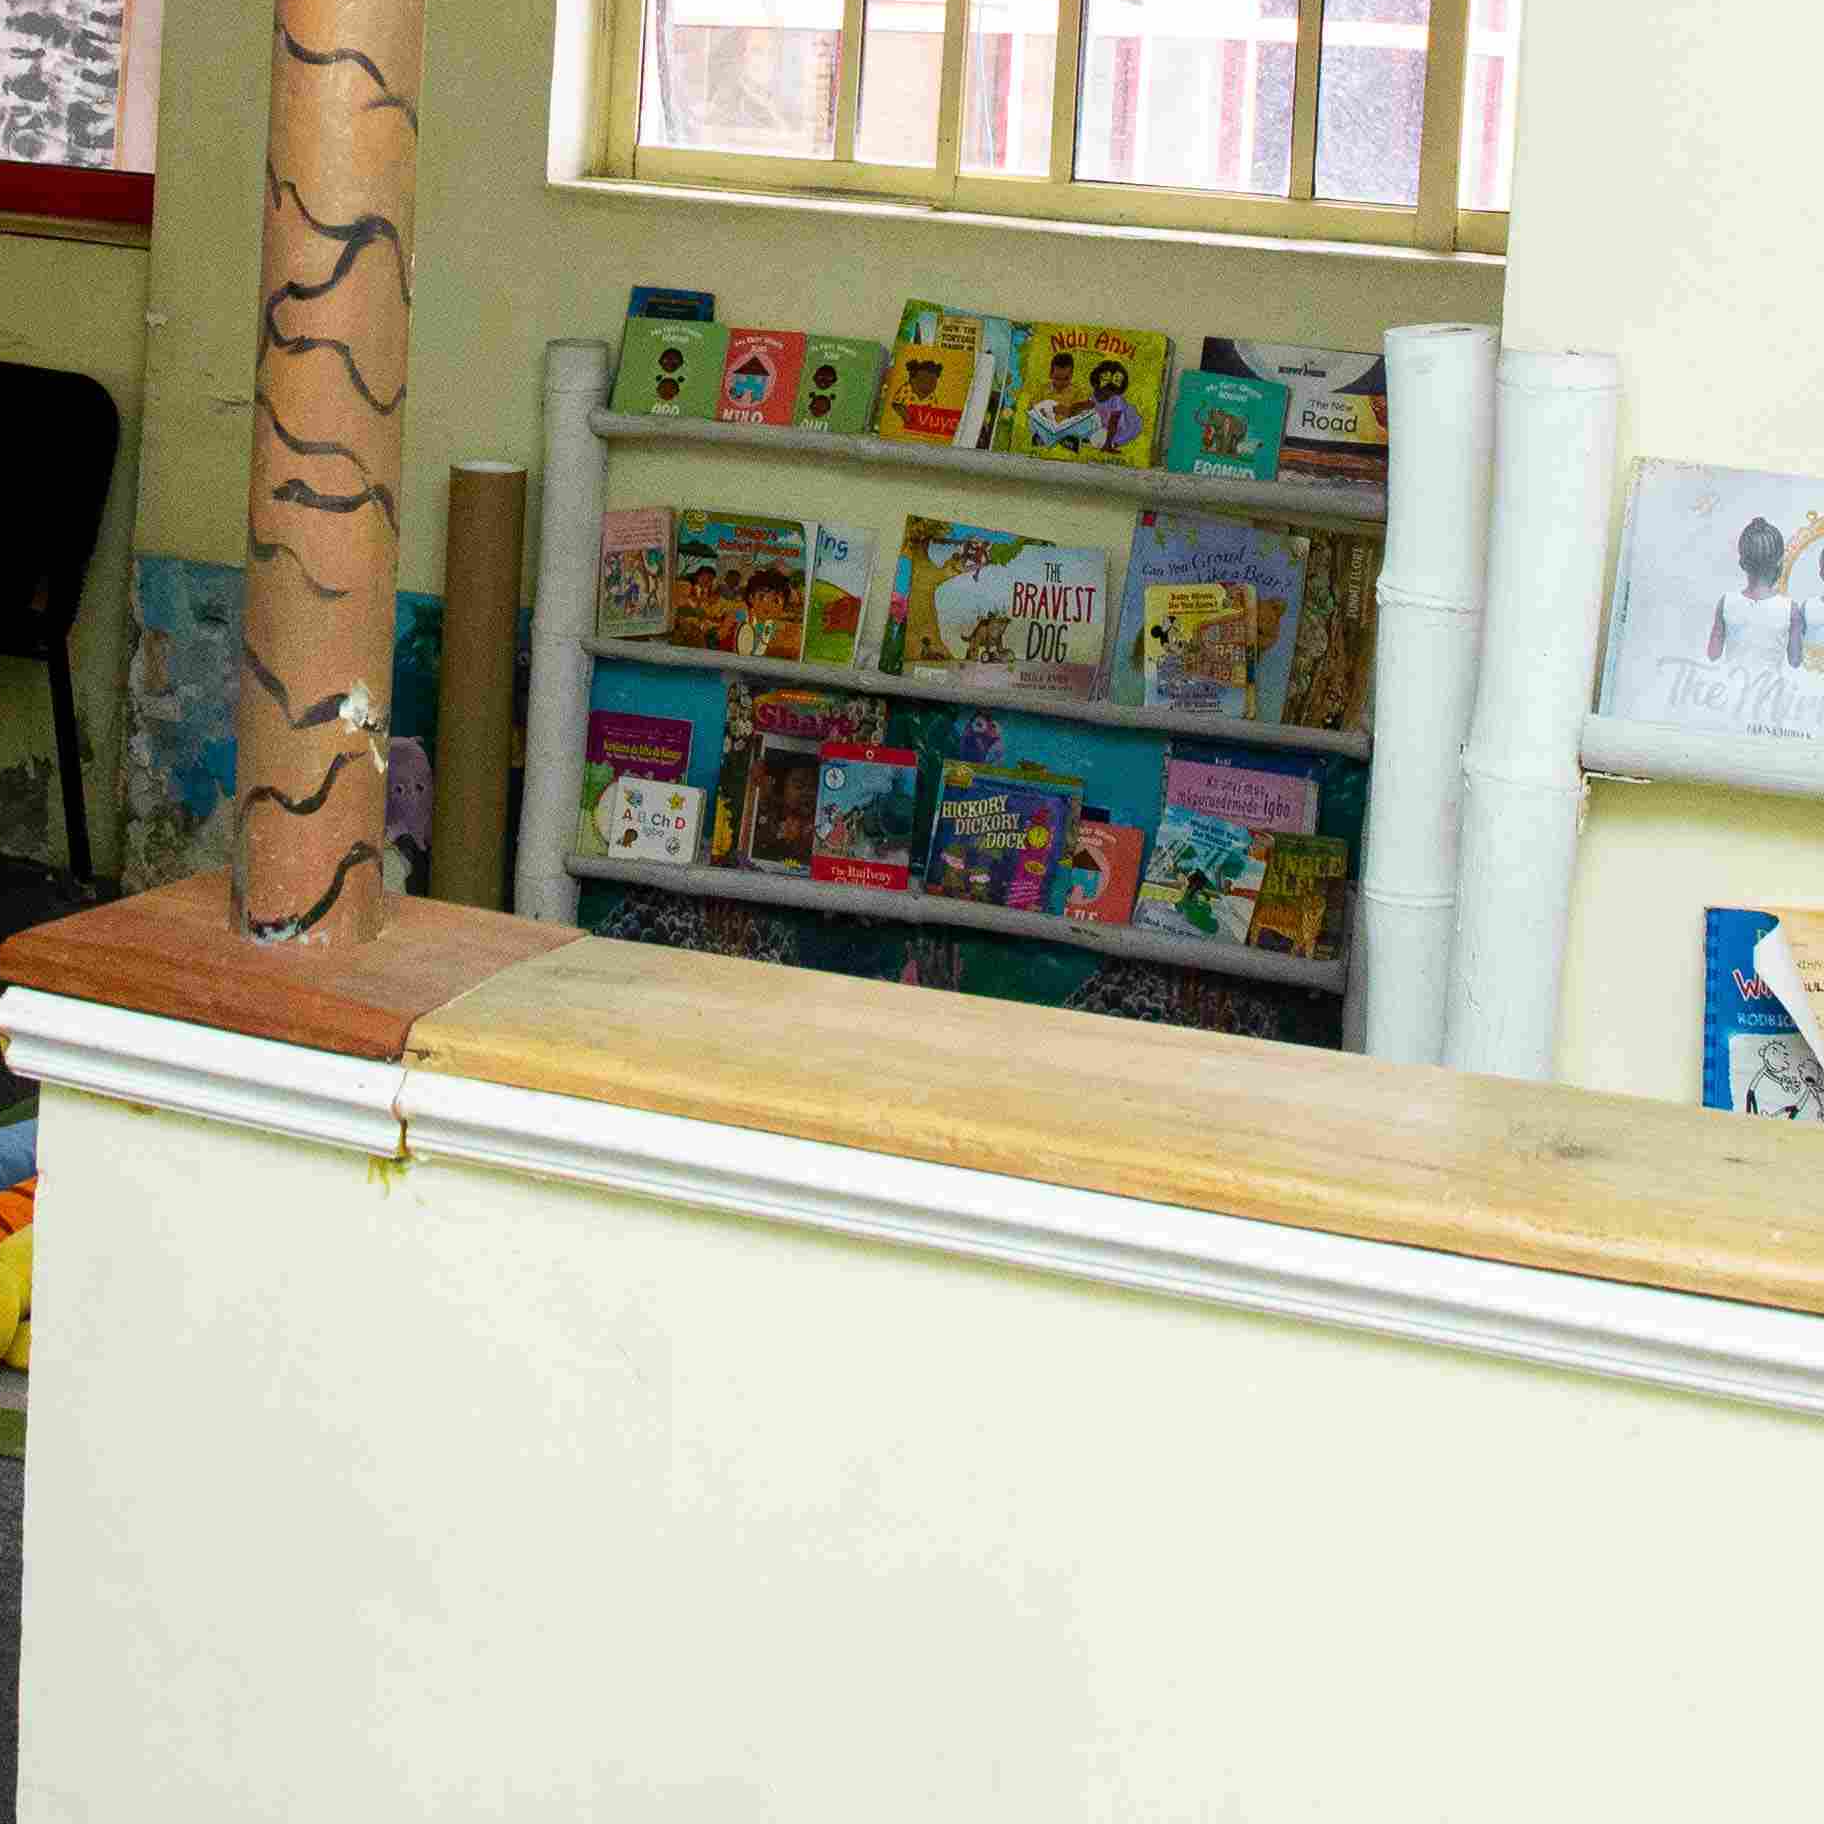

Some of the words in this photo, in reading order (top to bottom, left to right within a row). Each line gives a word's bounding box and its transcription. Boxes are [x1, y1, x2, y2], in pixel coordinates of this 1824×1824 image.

[1301, 408, 1357, 434] Road
[1045, 561, 1064, 584] THE
[1010, 582, 1096, 623] BRAVEST
[1026, 622, 1067, 663] DOG
[1656, 655, 1728, 709] The
[942, 794, 1008, 818] HICKORY
[651, 813, 671, 829] Ch
[954, 813, 1021, 835] DICKORY
[985, 830, 1027, 850] DOCK
